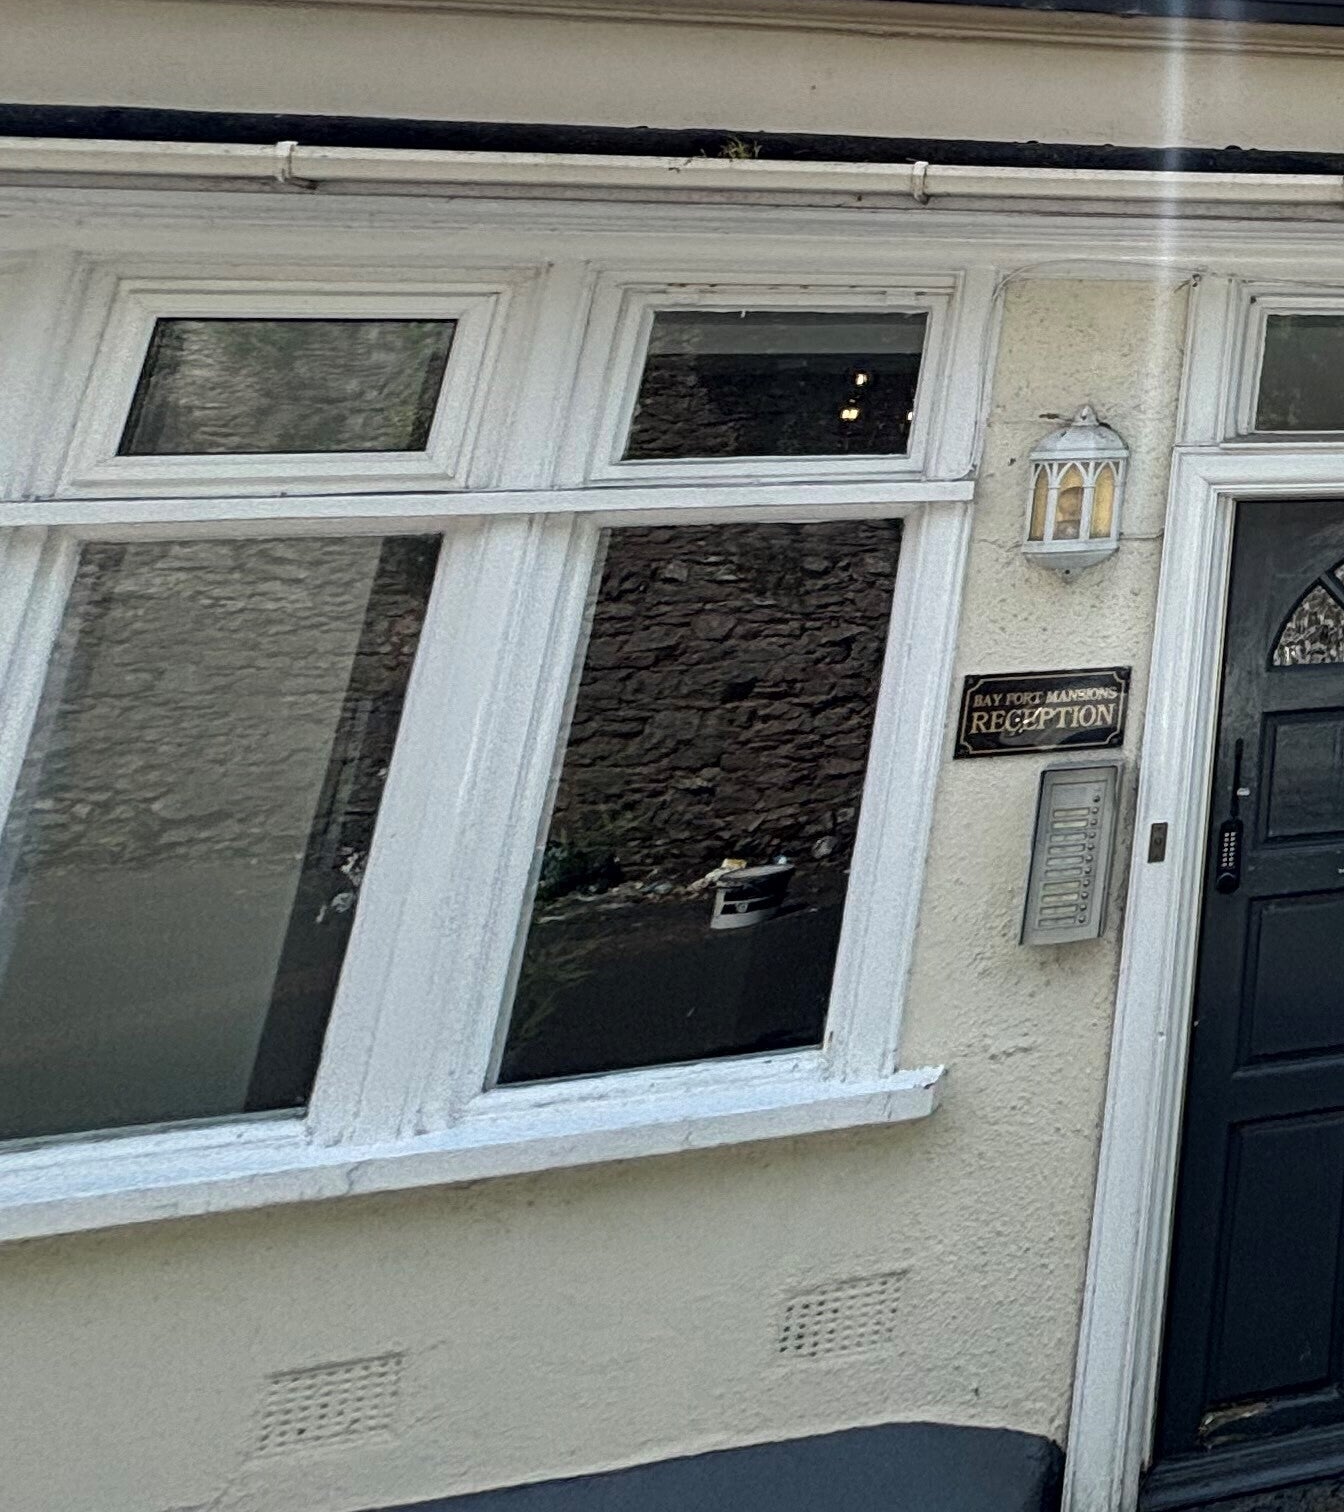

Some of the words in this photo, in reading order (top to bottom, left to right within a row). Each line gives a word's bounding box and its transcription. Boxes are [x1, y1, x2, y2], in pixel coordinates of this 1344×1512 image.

[973, 693, 1002, 707] BAY
[1005, 691, 1043, 706] FORT
[1045, 687, 1118, 704] MANSIONS
[969, 703, 1116, 734] RECEPTION
